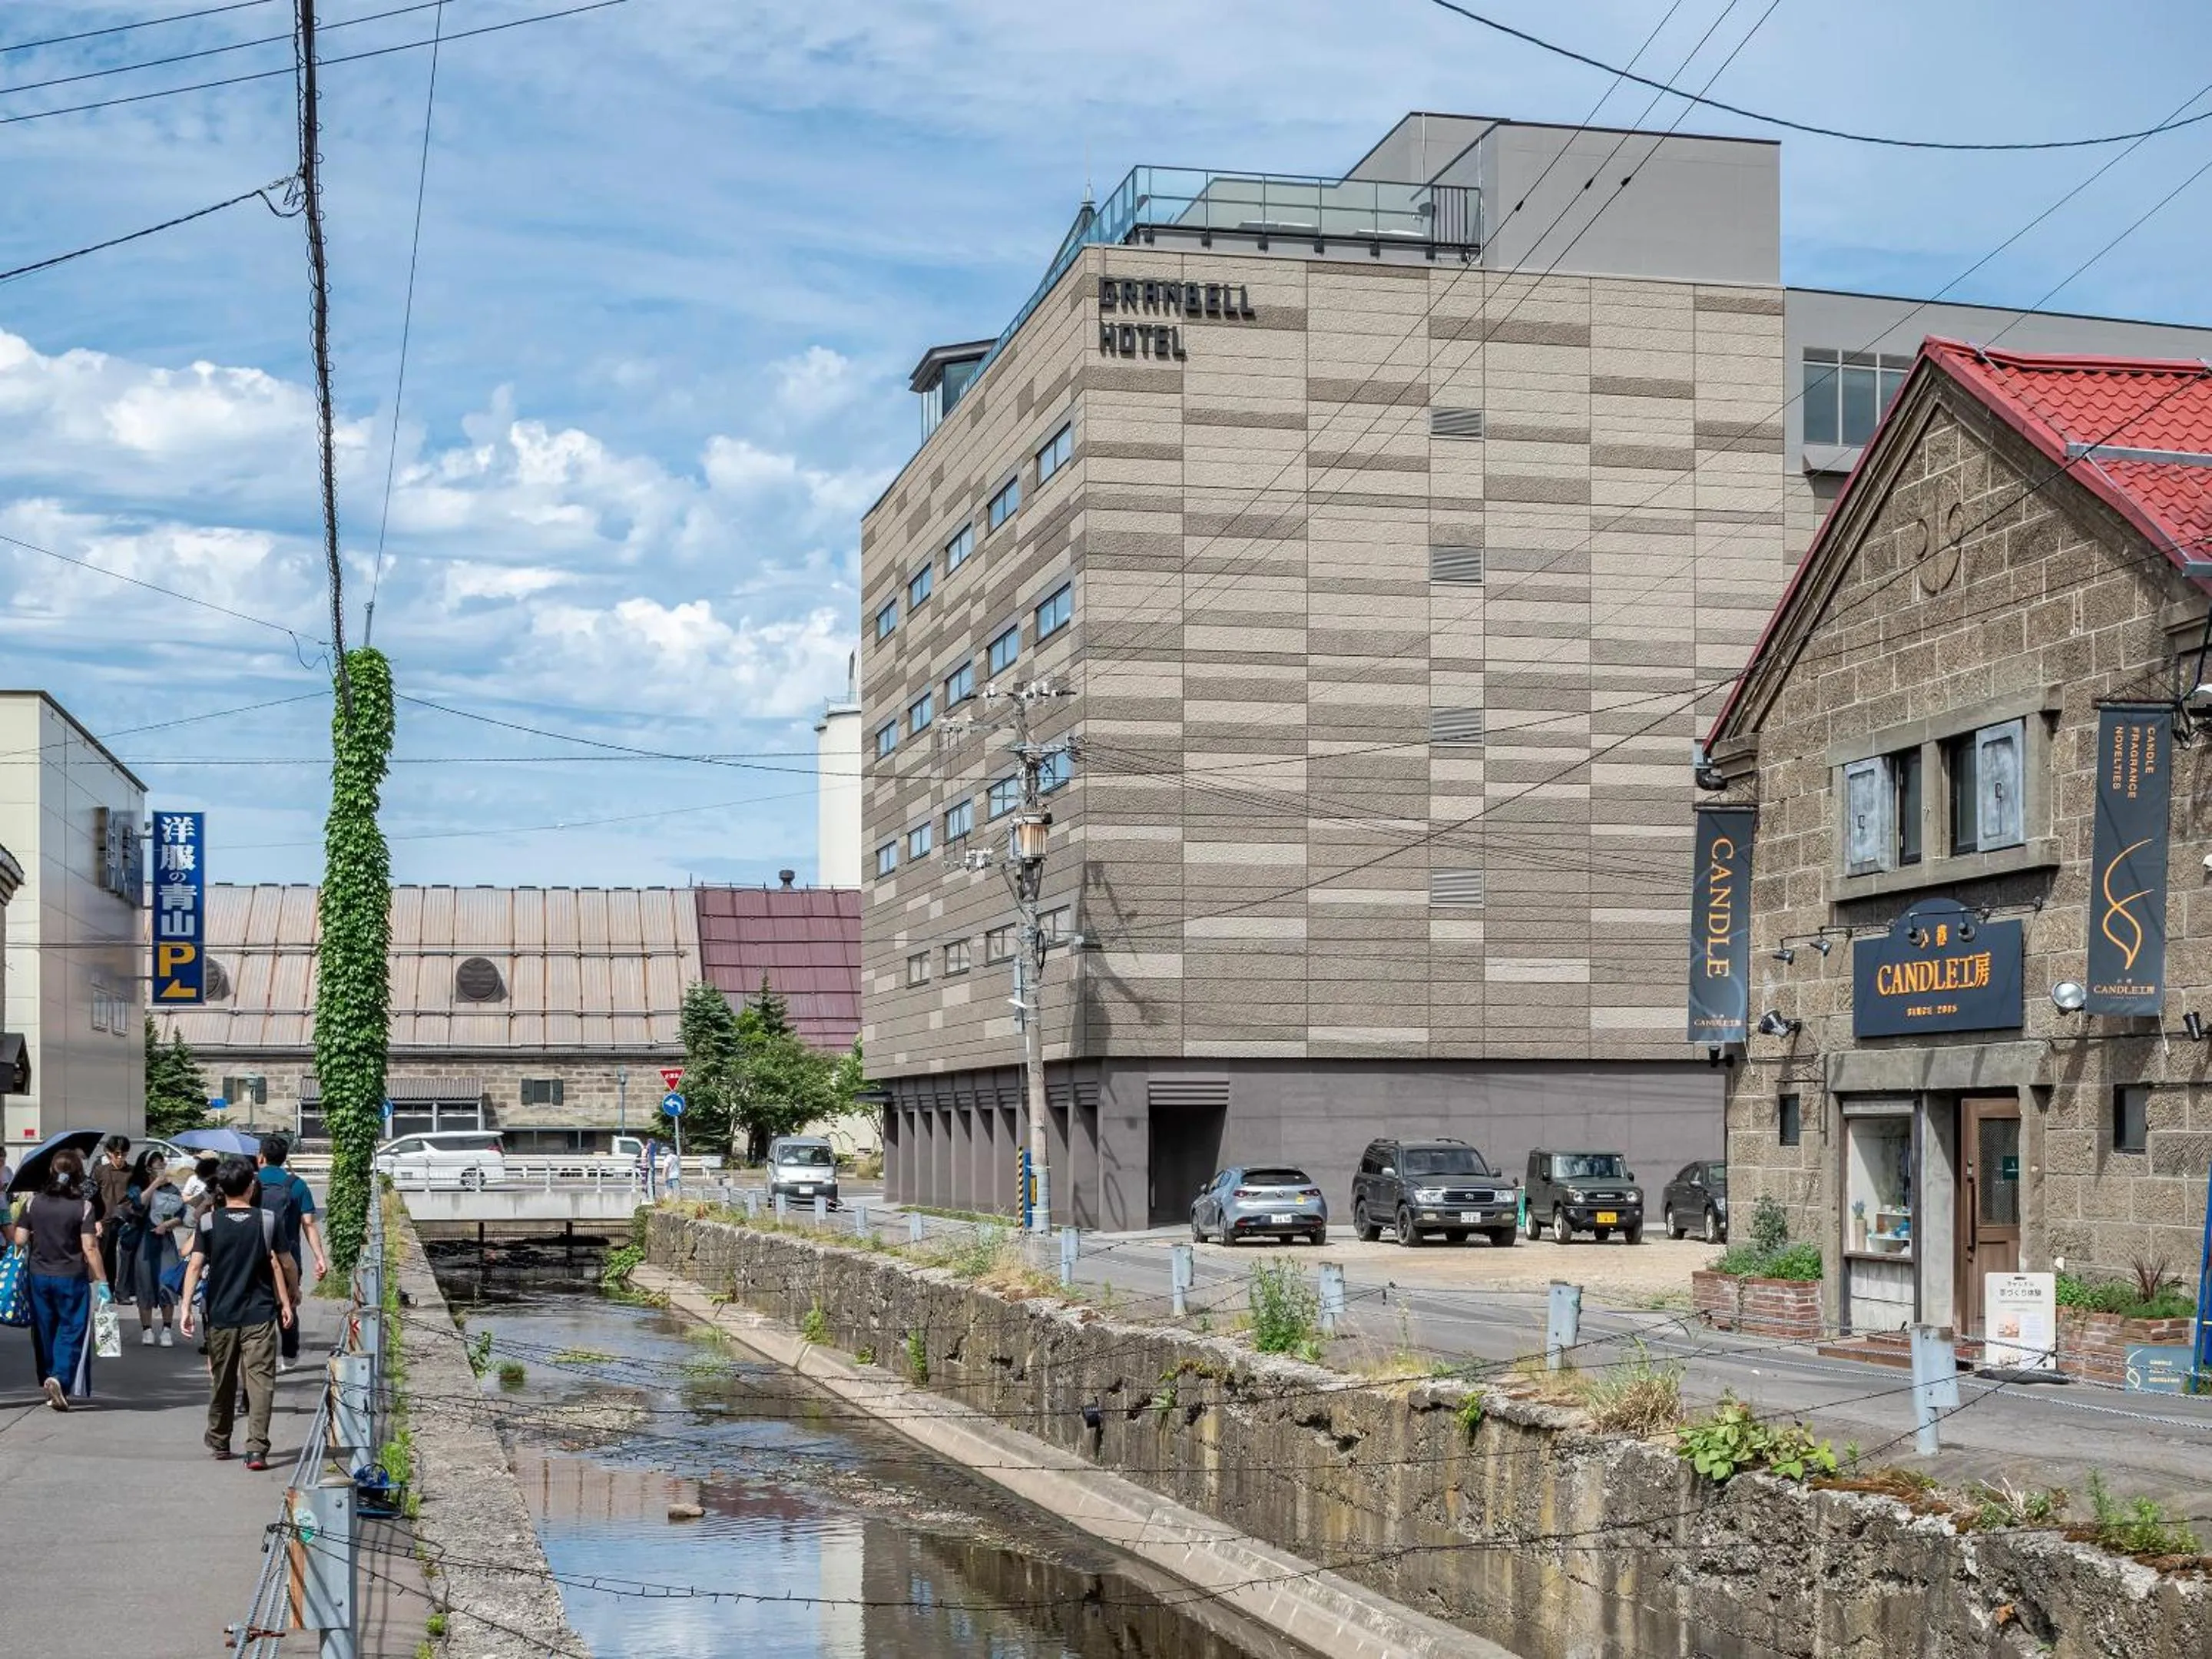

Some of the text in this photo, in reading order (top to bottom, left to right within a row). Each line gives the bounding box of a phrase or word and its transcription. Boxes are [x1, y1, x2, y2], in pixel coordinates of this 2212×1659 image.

[1099, 277, 1254, 315] GRANBELL
[1100, 321, 1186, 356] HOTEL
[2112, 726, 2124, 790] NOVELTIES
[2128, 727, 2141, 798] FRAGRANCE
[2145, 727, 2156, 774] CANDLE
[159, 816, 197, 936] 洋服の青山
[1707, 838, 1734, 978] CANDLE
[159, 942, 195, 976] P
[1878, 952, 1990, 995] CANDLE工房
